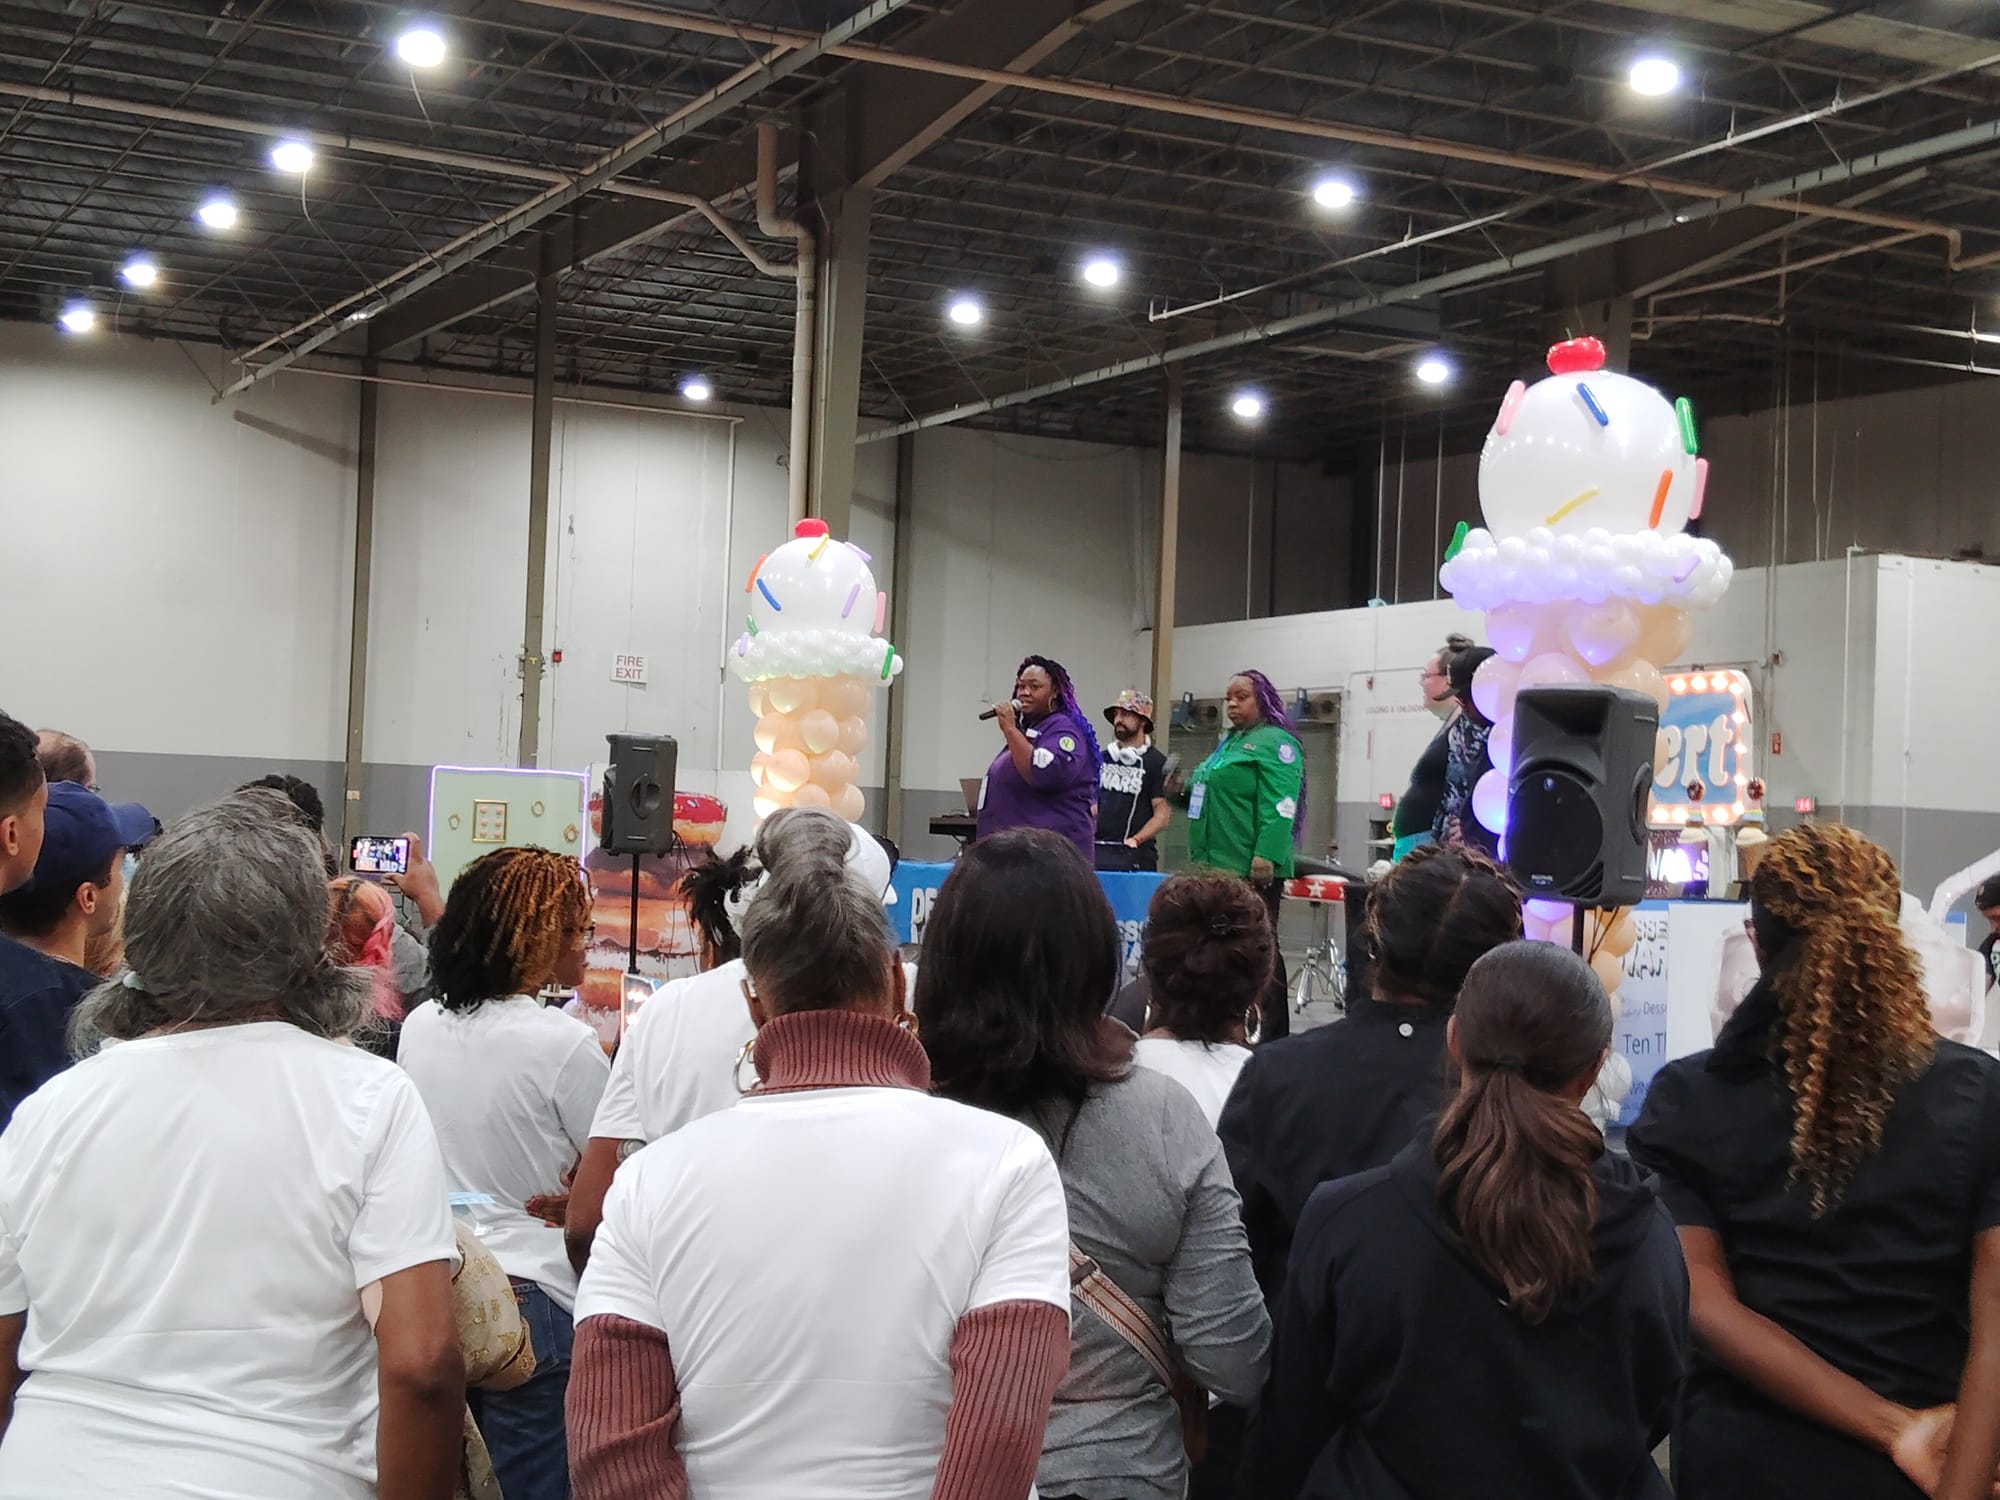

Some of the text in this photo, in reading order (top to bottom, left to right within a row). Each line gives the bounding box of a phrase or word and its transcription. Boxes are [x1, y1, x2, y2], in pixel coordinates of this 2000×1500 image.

[616, 655, 644, 667] FIRE
[615, 667, 643, 680] EXIT
[1100, 773, 1143, 794] WARS
[1623, 1034, 1650, 1055] Ten
